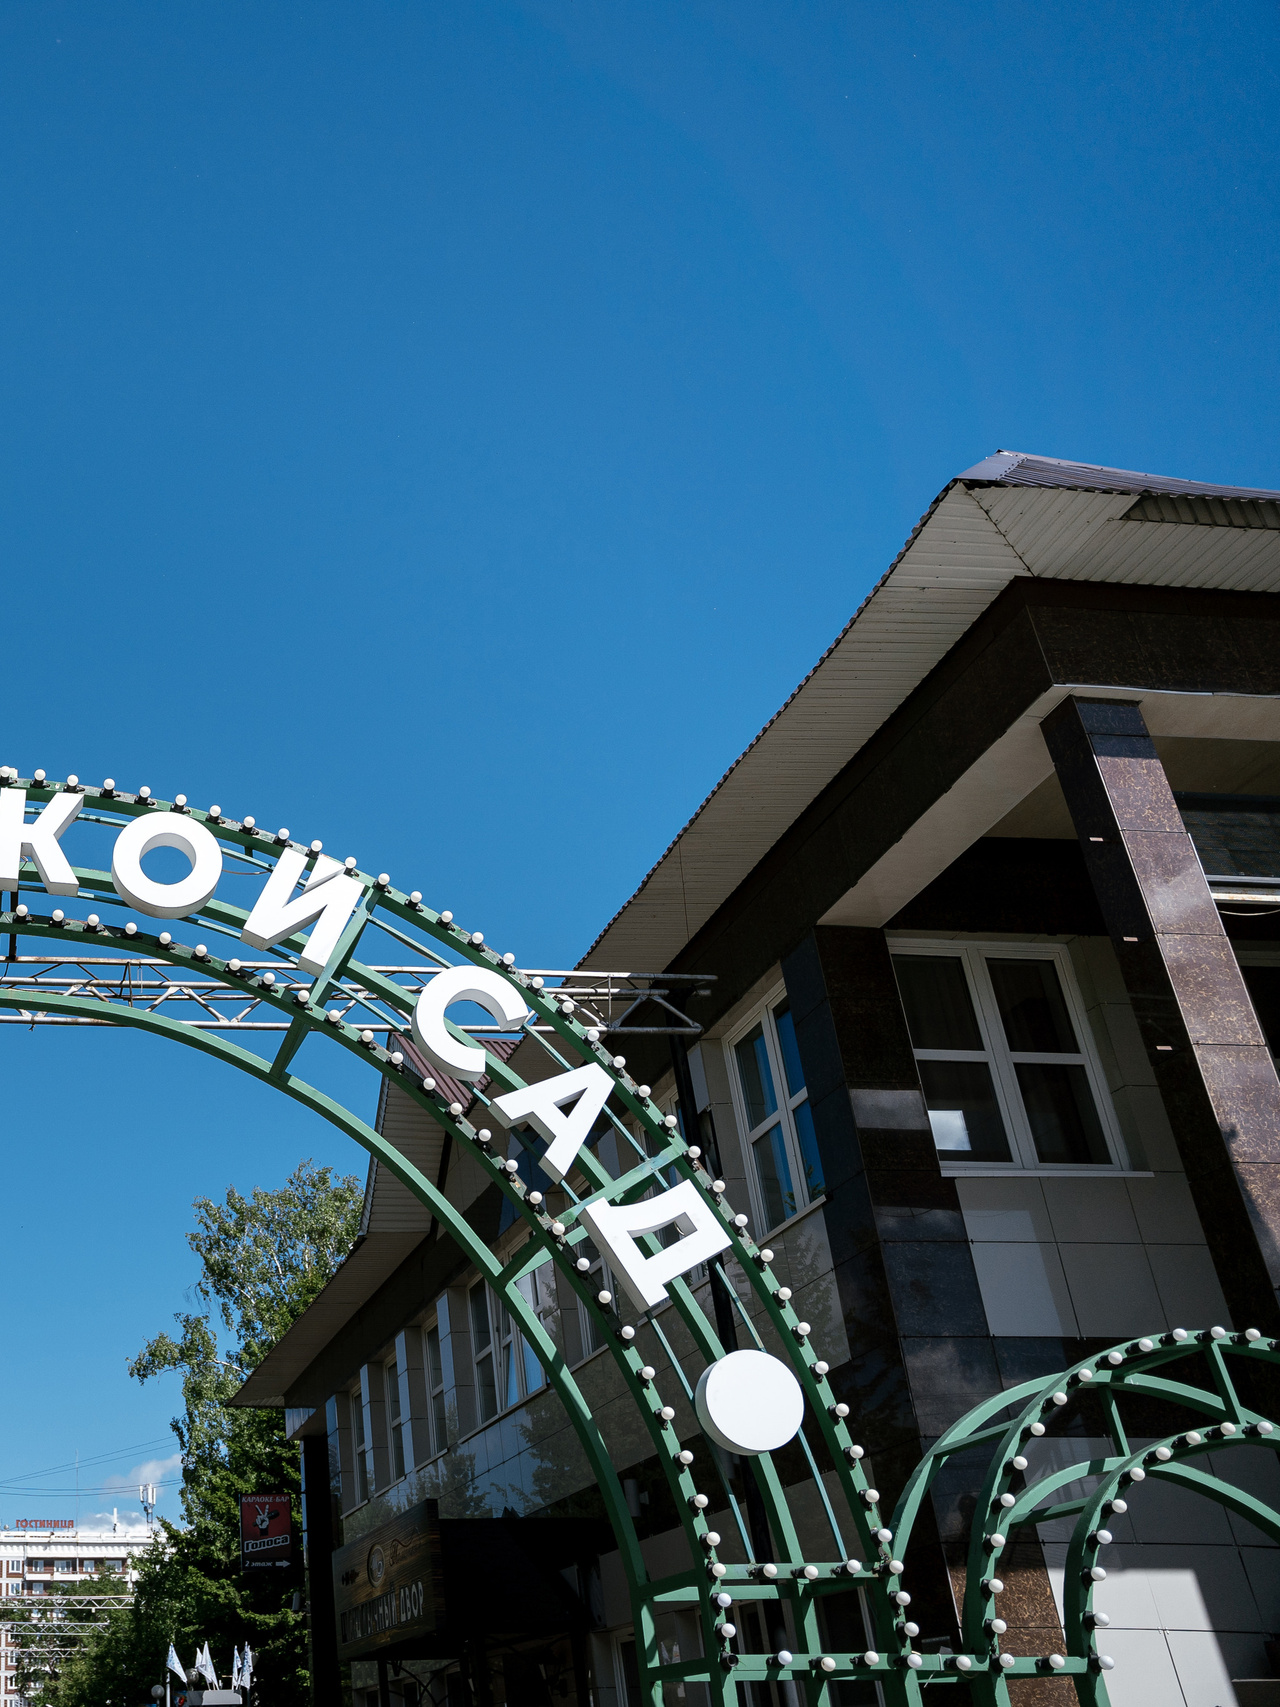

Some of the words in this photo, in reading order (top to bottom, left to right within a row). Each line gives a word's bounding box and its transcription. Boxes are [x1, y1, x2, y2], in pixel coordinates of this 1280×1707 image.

[411, 965, 732, 1313] САД
[15, 1519, 74, 1529] ГОСТИНИЦА
[244, 1534, 290, 1553] Голоса
[400, 1579, 424, 1622] ДВОР
